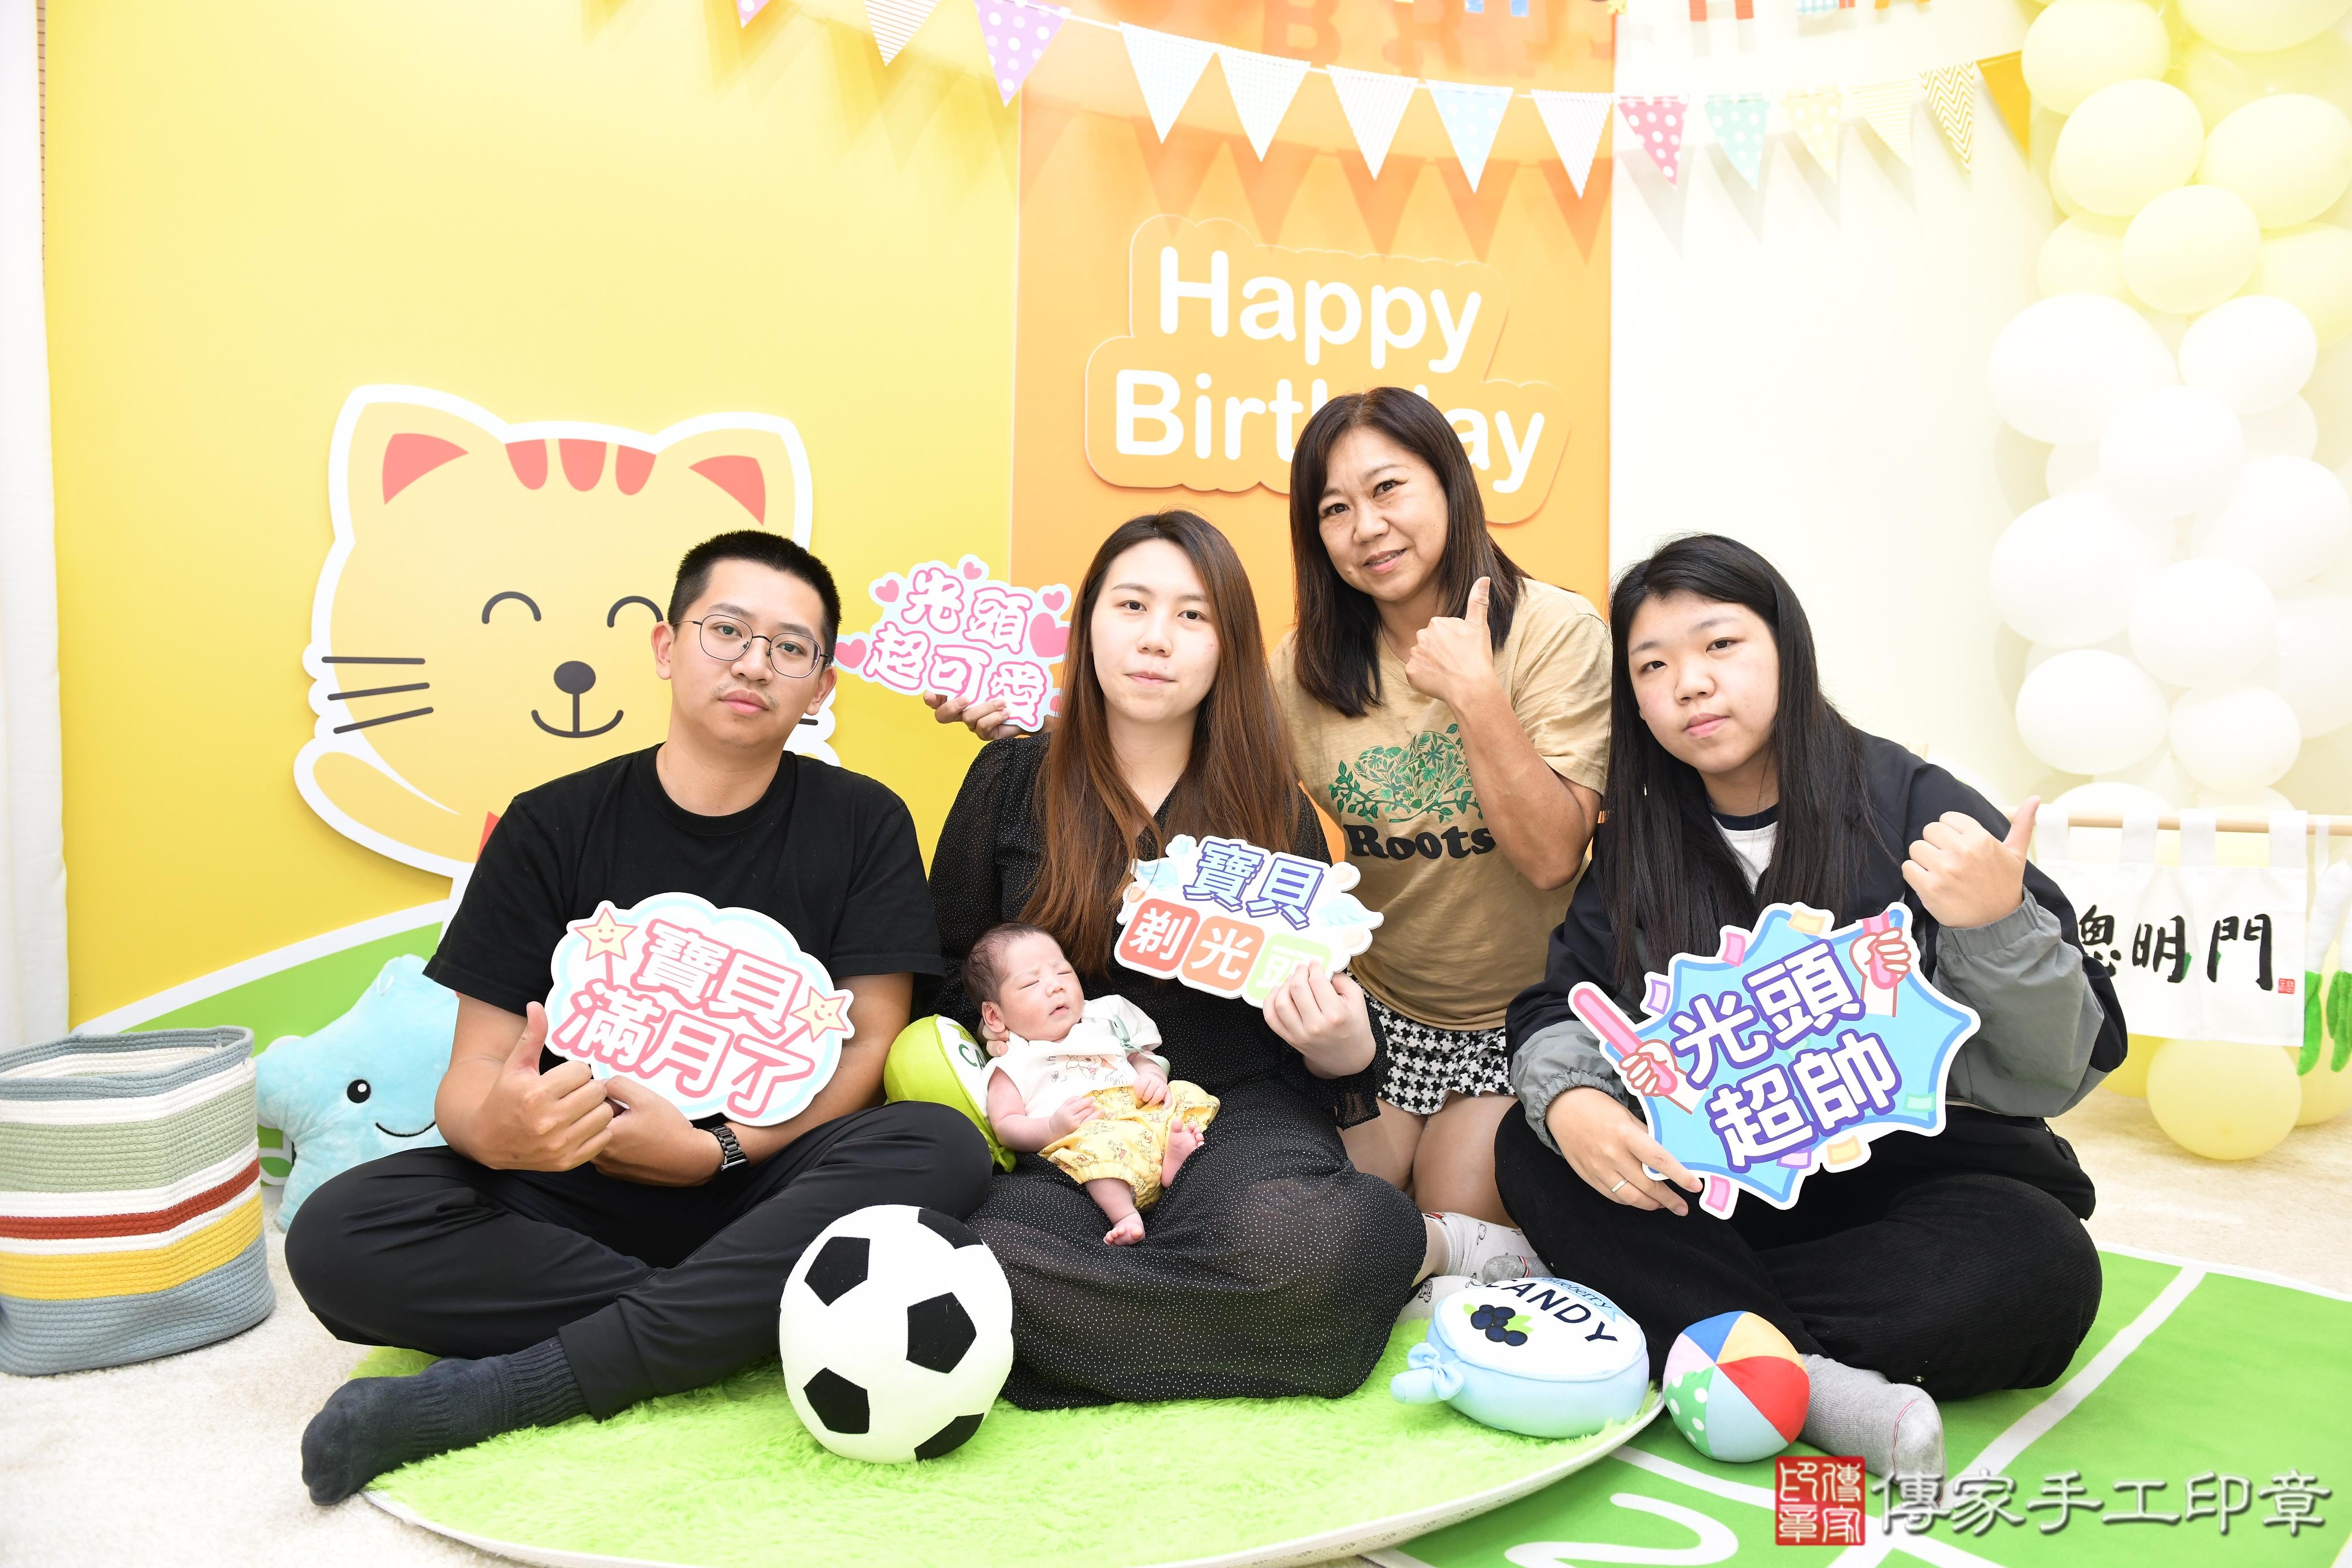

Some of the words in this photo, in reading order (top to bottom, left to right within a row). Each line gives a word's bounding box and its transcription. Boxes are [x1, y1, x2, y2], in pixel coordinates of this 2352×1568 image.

[1160, 246, 1481, 373] Happy
[1115, 369, 1545, 493] Birtay
[901, 567, 1032, 654] 光頭
[863, 621, 1047, 726] 超可愛
[1183, 841, 1324, 930] 寶貝
[1344, 824, 1496, 860] Roots
[630, 919, 802, 1039] 寶貝
[1669, 939, 1865, 1090] 光頭
[552, 978, 815, 1118] 滿月了
[1705, 1028, 1902, 1173] 超帥
